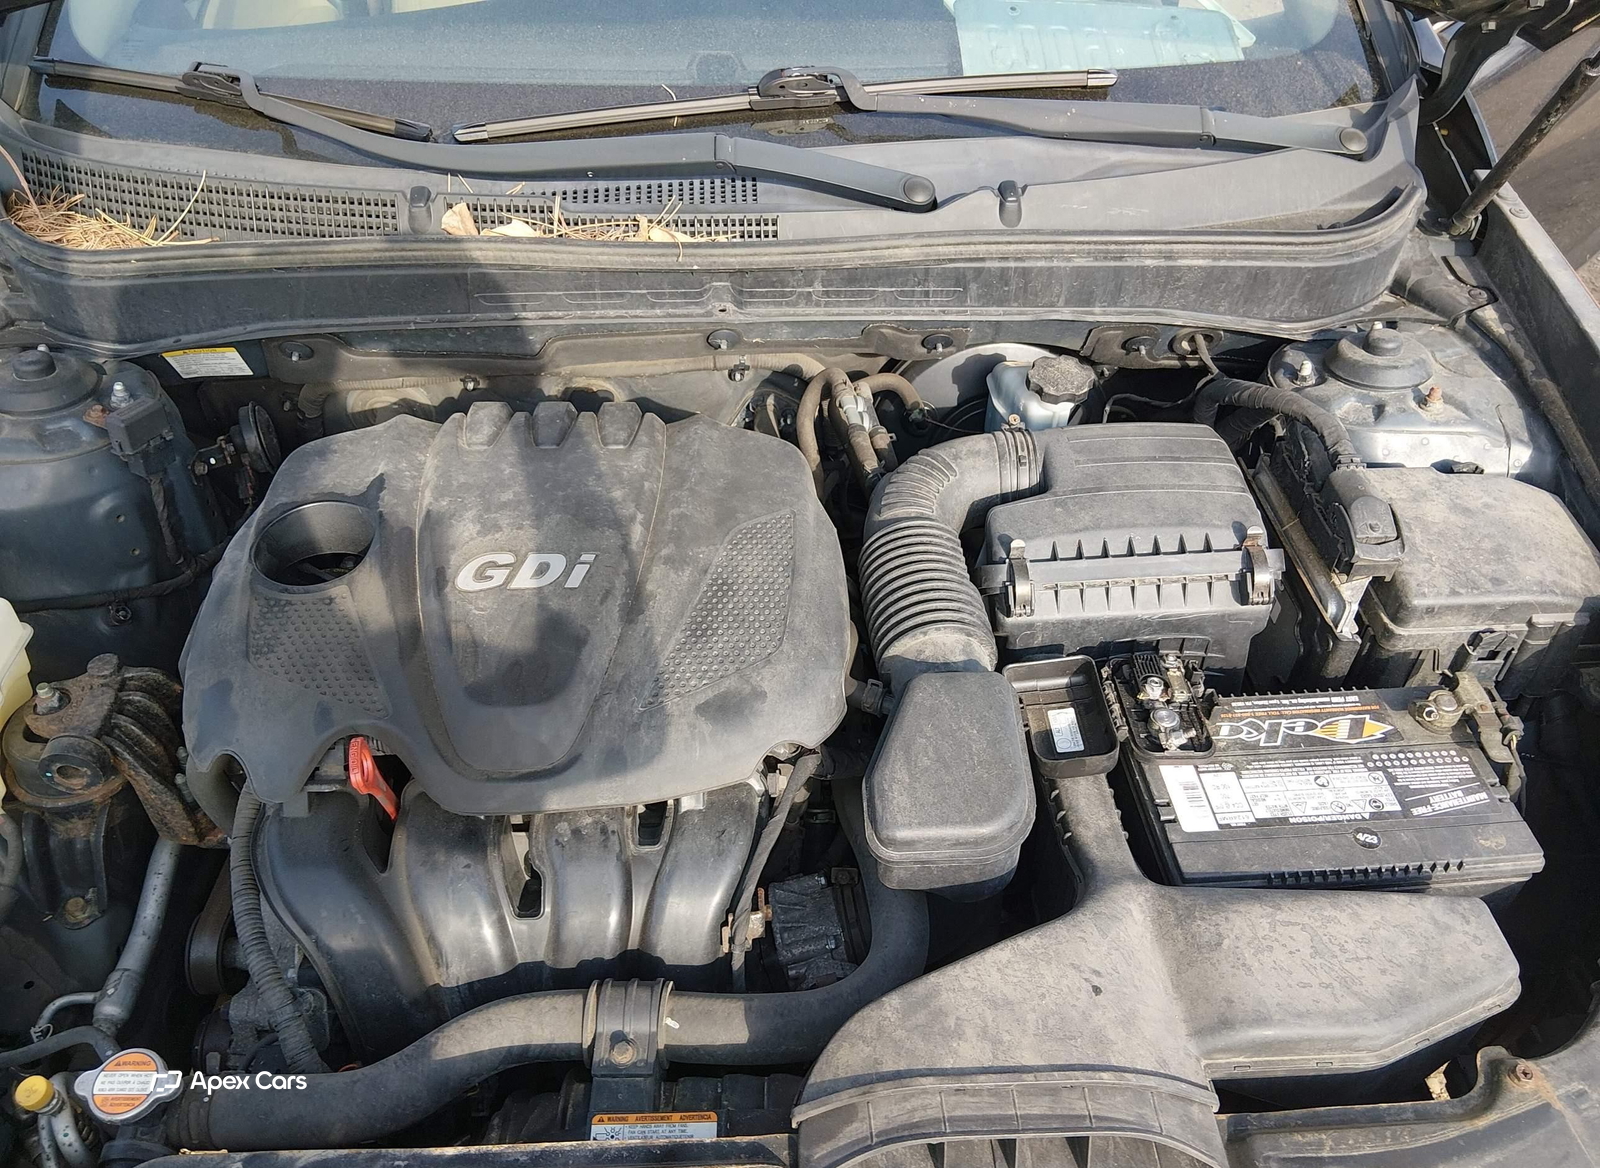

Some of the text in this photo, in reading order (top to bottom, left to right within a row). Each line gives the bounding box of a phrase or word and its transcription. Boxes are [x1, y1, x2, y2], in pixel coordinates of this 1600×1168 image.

[455, 552, 598, 592] GDi
[1211, 714, 1394, 746] Deka
[1410, 791, 1488, 816] MAINTENANCE-FREE
[1428, 790, 1464, 804] BATTERY
[1289, 813, 1362, 824] DANGER/POISON
[1356, 832, 1378, 844] 4/23
